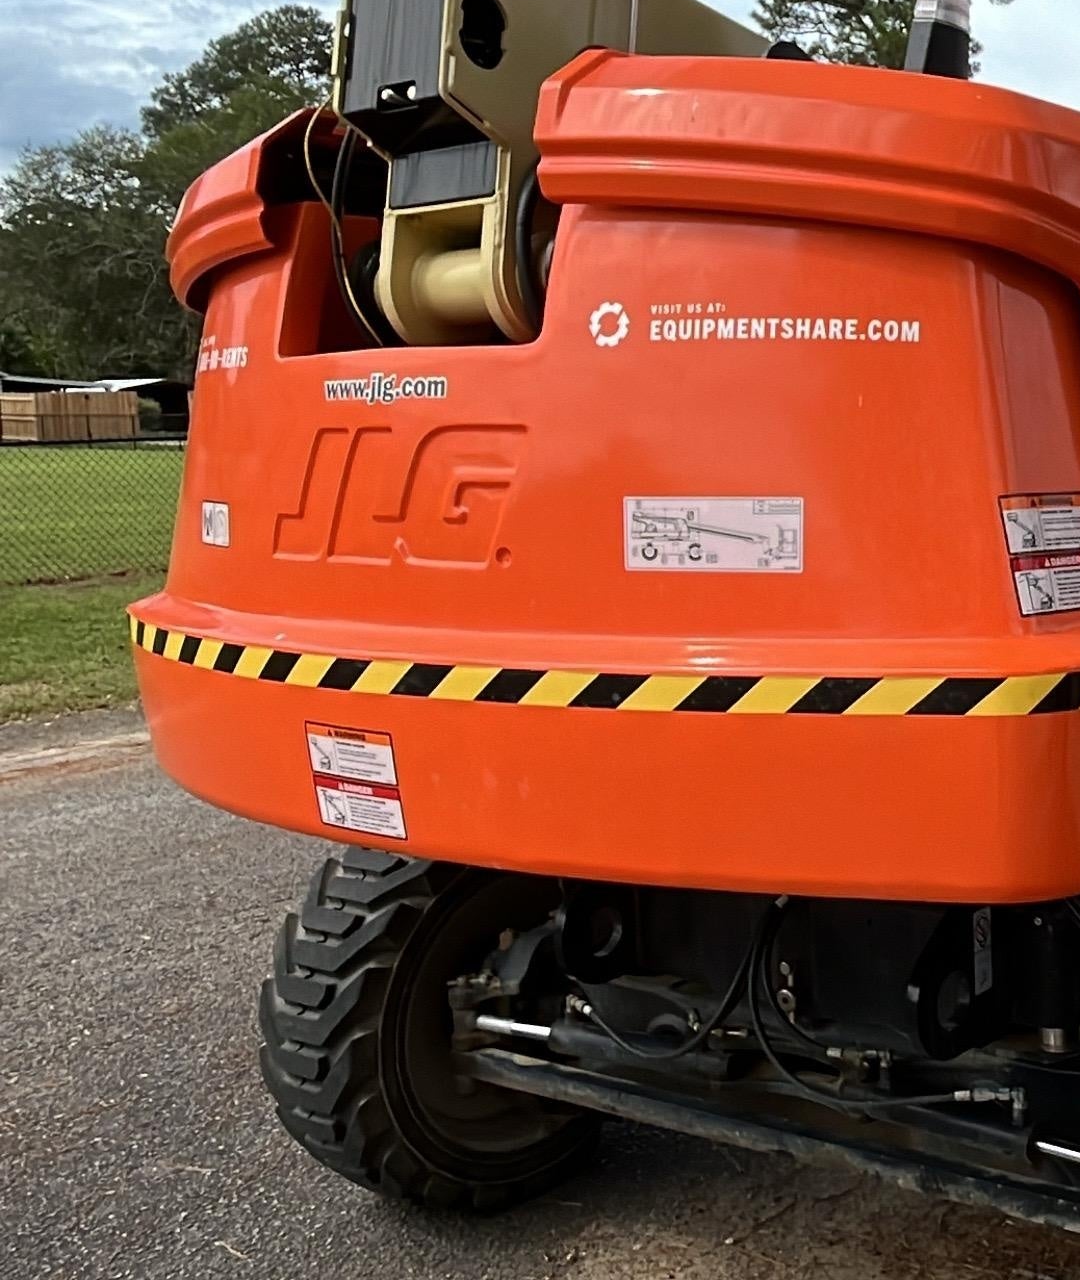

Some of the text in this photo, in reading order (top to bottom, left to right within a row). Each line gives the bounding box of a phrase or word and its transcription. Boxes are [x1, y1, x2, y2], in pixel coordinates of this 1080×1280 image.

[650, 303, 682, 315] VISIT
[687, 303, 702, 314] US
[649, 317, 921, 343] EQUIPMENTSHARE.COM
[326, 374, 446, 404] www.jlg.com
[272, 423, 528, 570] JLG
